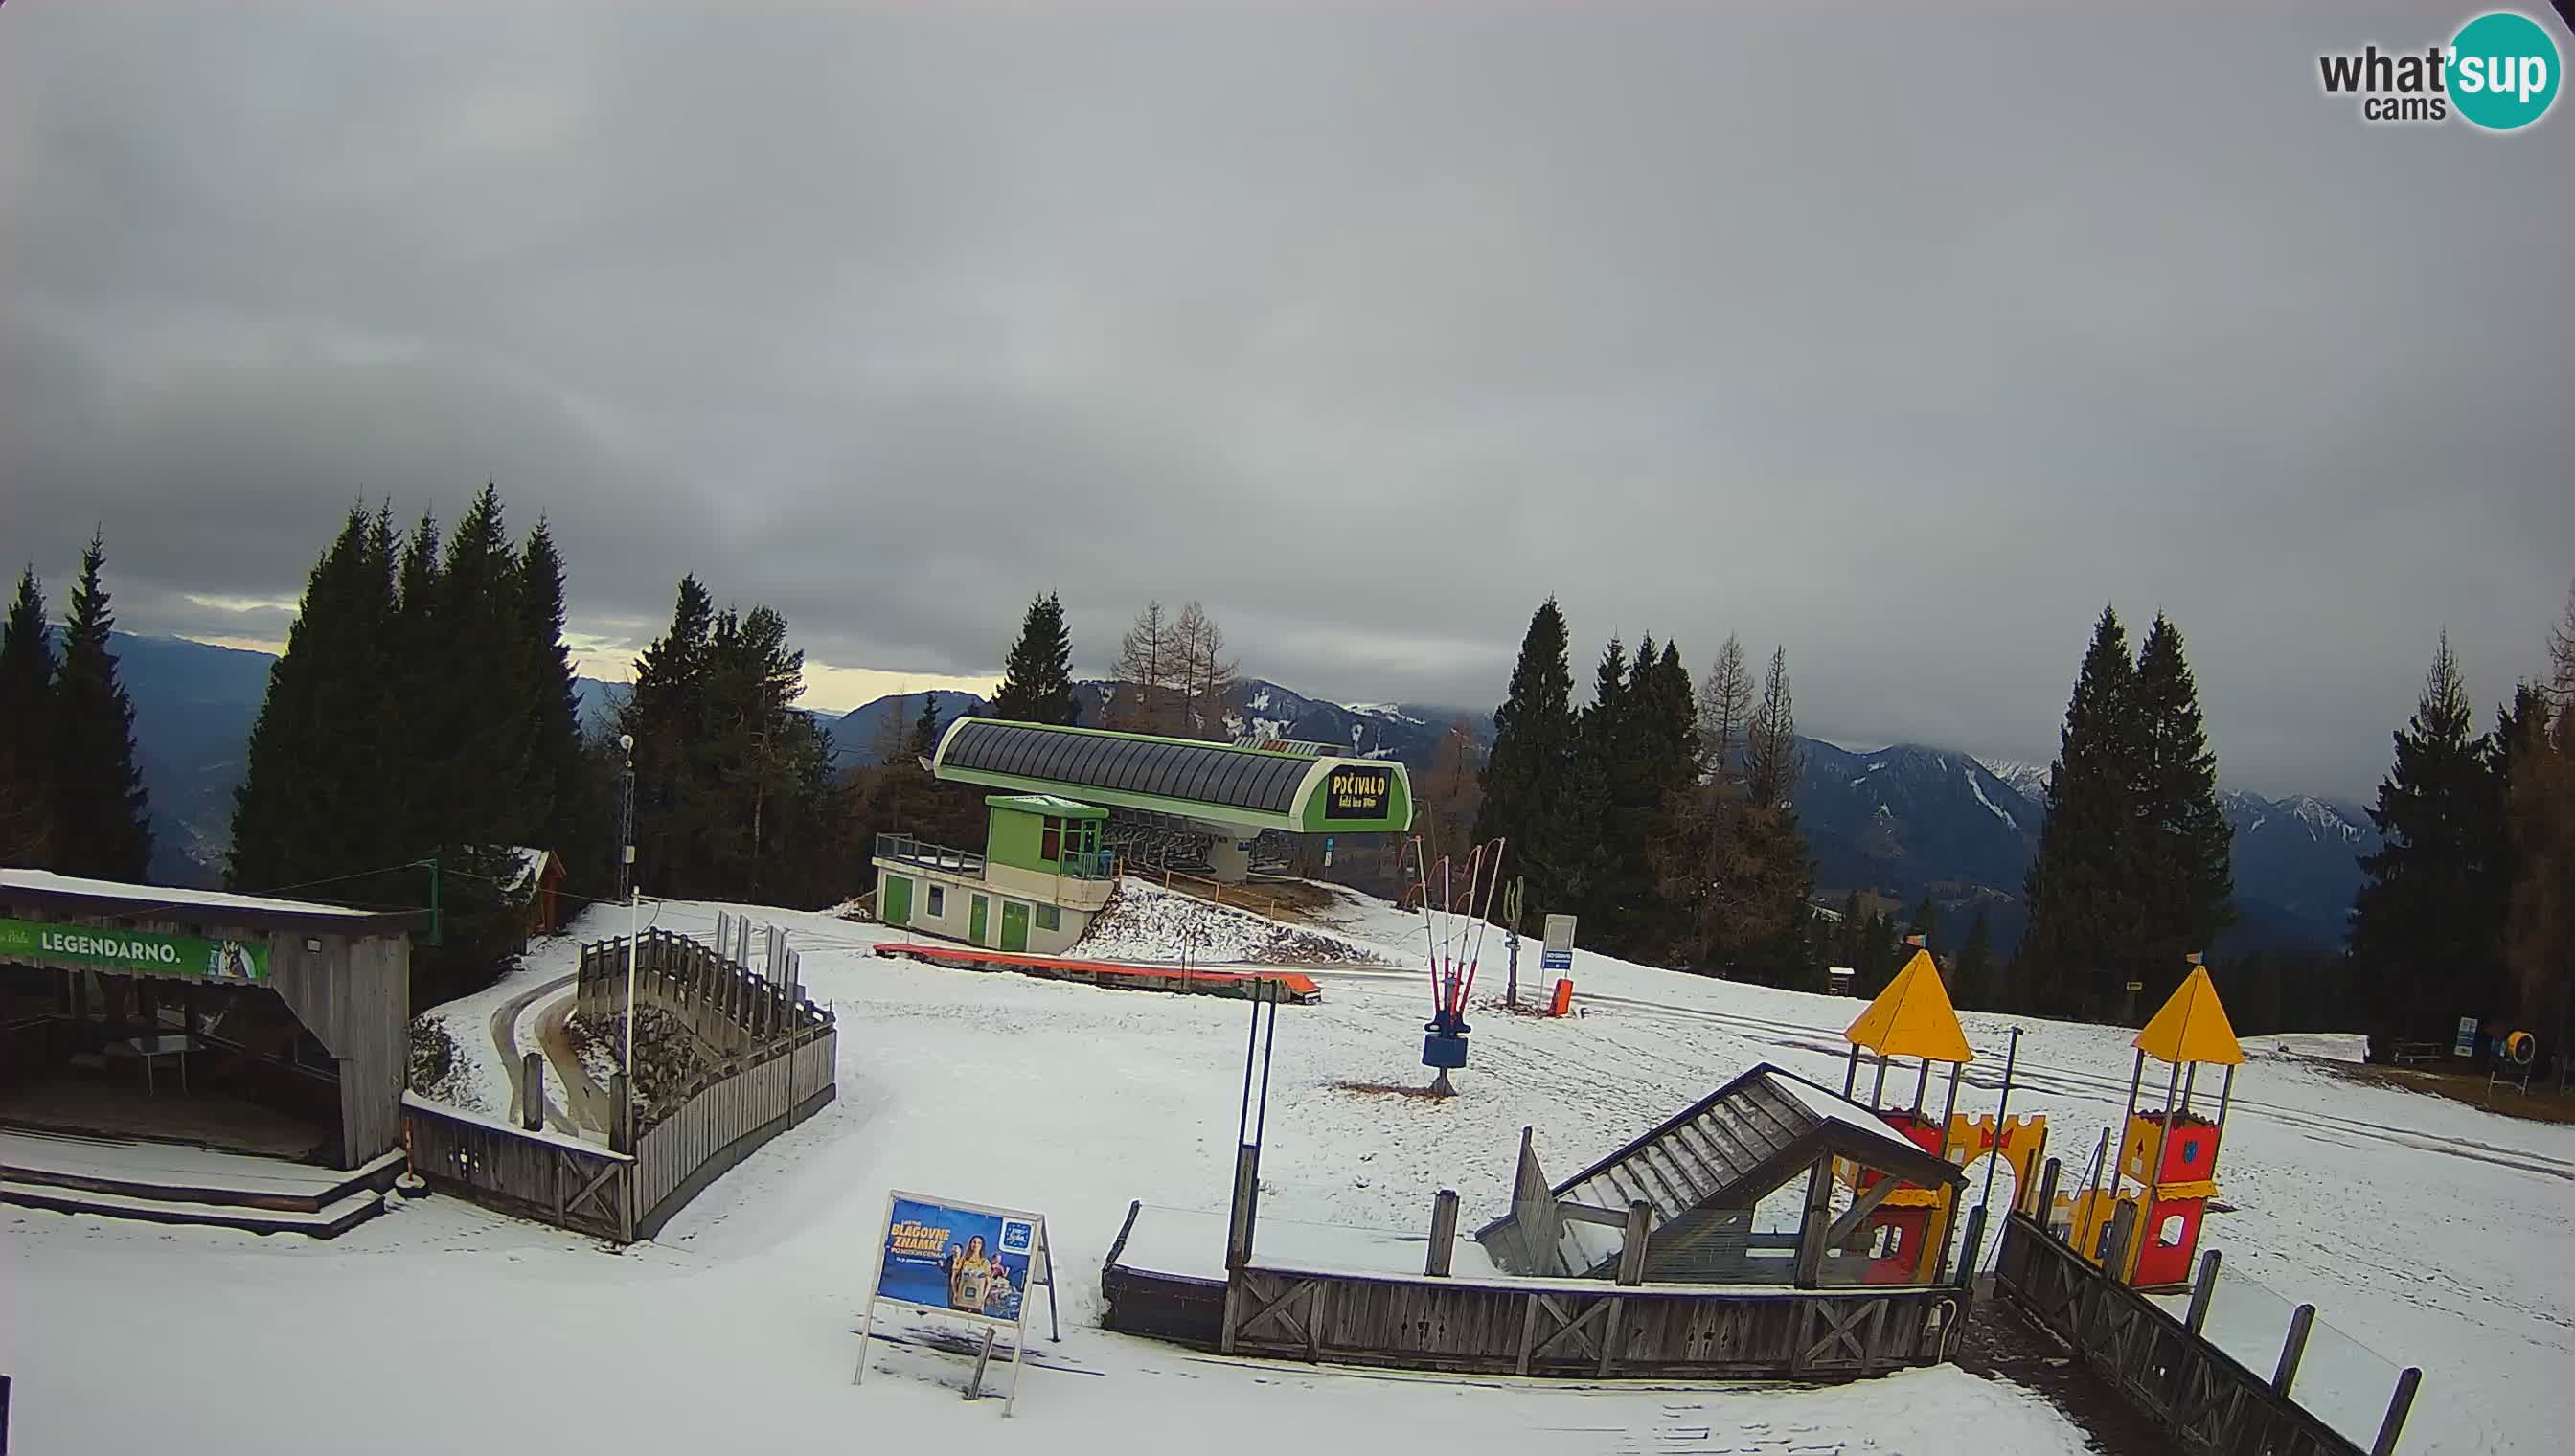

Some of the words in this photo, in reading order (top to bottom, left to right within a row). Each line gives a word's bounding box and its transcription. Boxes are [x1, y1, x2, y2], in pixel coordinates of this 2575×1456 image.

[41, 931, 182, 964] LEGENDARNO.
[892, 1223, 950, 1240] BLAGOVNE
[894, 1236, 944, 1251] ZNAMKE
